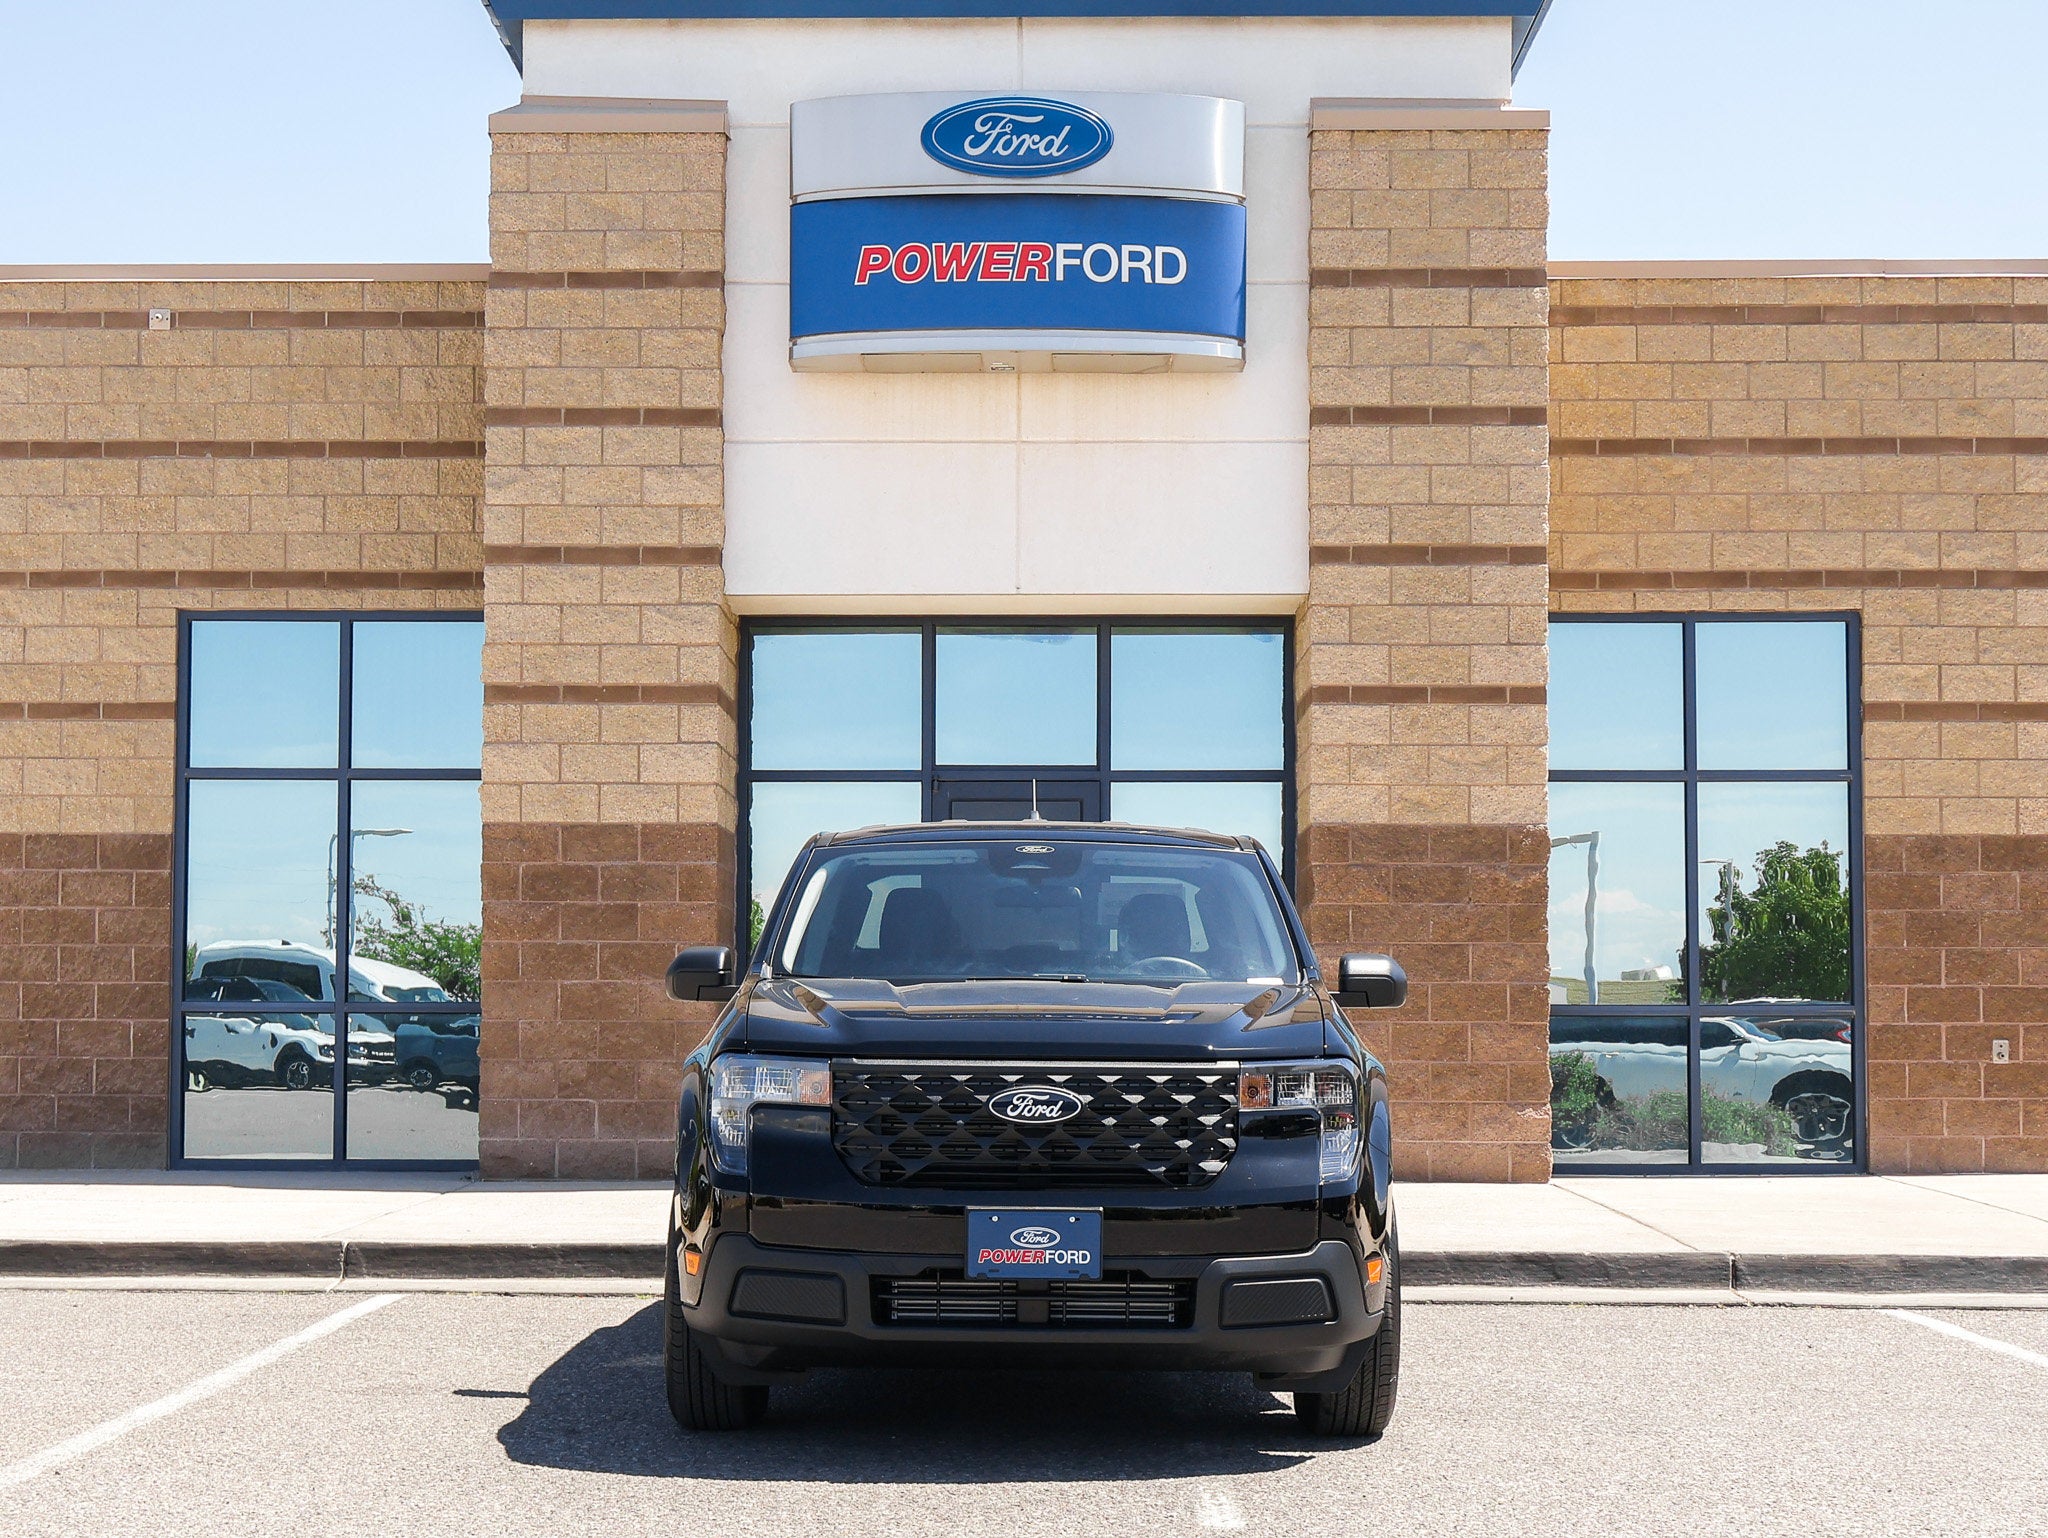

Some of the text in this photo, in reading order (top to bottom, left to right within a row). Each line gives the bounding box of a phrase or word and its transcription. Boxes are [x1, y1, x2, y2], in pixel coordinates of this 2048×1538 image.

[963, 111, 1071, 158] Ford
[854, 242, 1188, 286] POWERFORD
[1006, 1093, 1063, 1118] Ford
[1020, 1231, 1050, 1244] Ford
[978, 1249, 1091, 1264] POWERFORD
